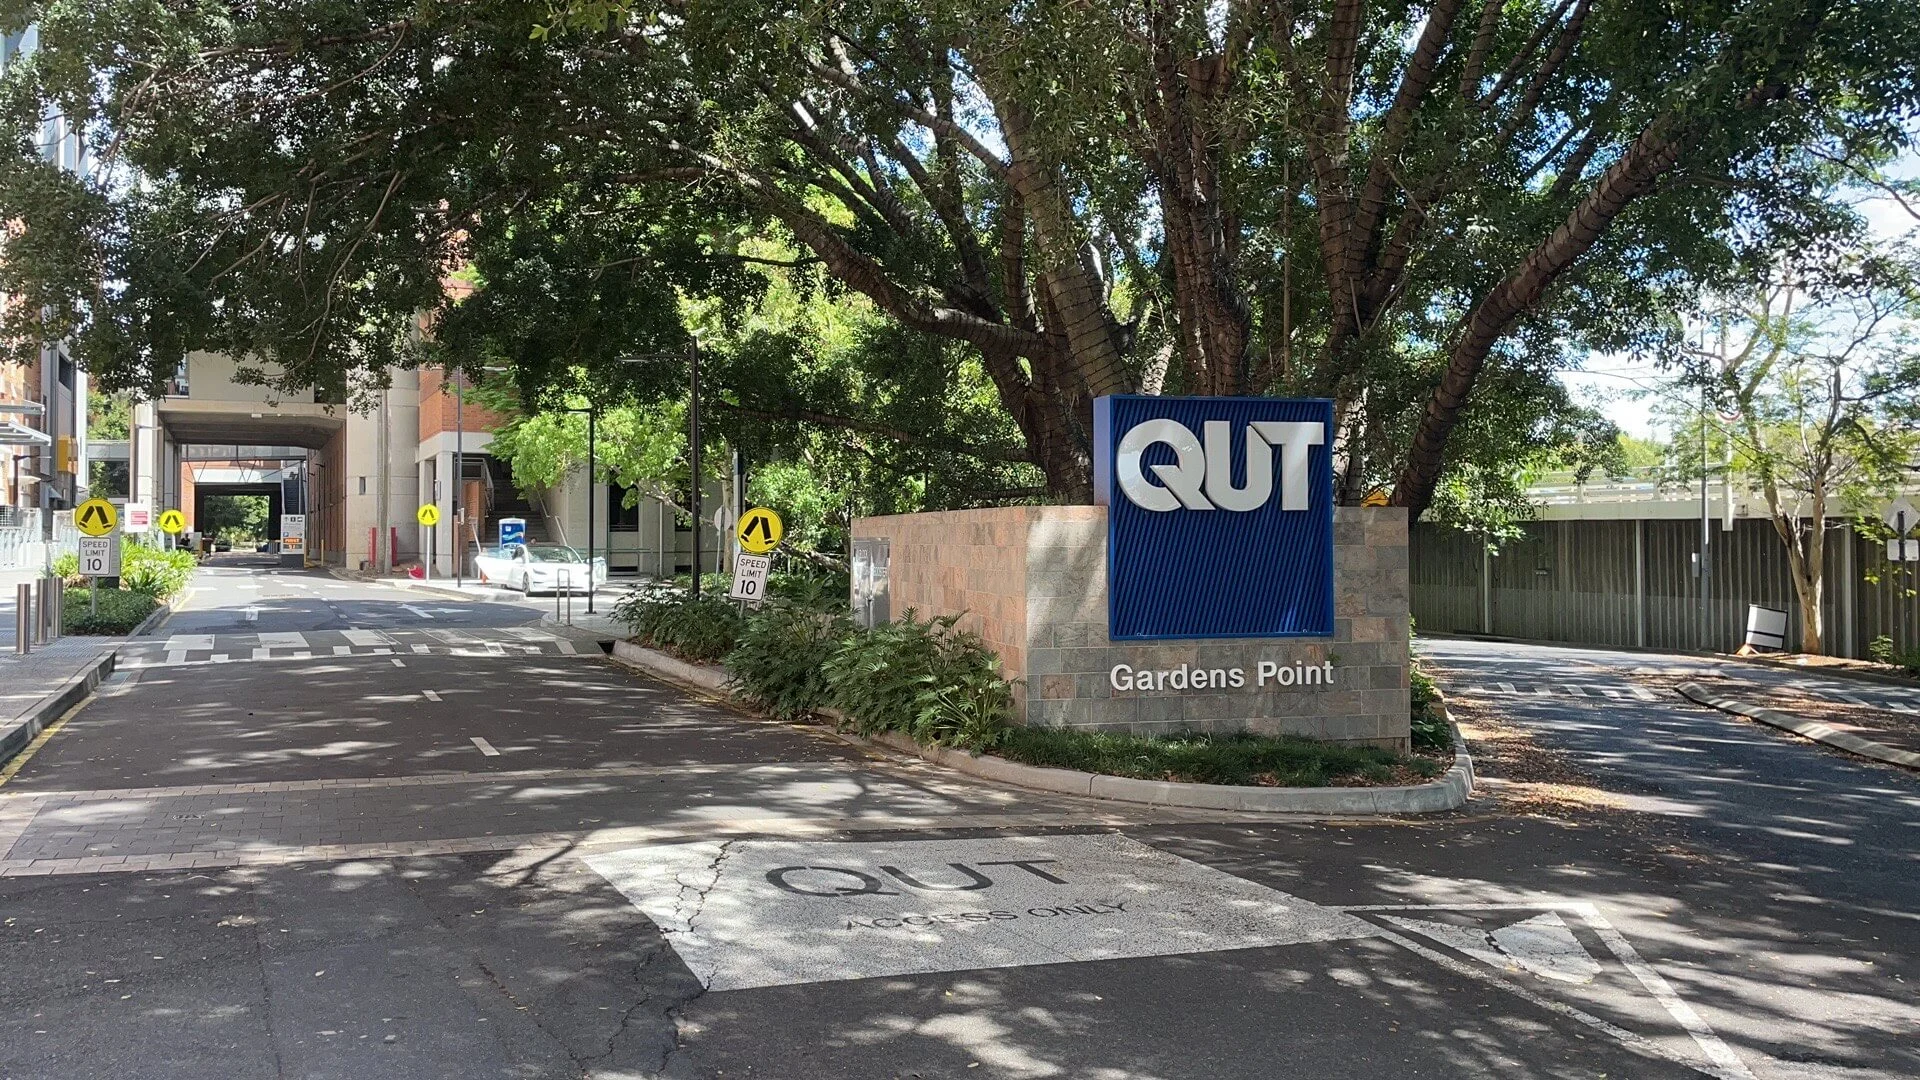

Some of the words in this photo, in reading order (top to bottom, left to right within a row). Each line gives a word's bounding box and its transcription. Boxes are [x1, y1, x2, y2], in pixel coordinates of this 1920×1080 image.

[1116, 418, 1325, 512] QUT
[87, 558, 102, 571] 10
[740, 558, 767, 569] SPEED
[741, 569, 762, 579] LIMIT
[740, 580, 756, 595] 10
[1110, 663, 1246, 692] Gardens
[1257, 660, 1335, 687] Point
[765, 859, 1069, 898] QUT
[846, 910, 1019, 931] ACCESS
[1027, 901, 1131, 918] ONLY
